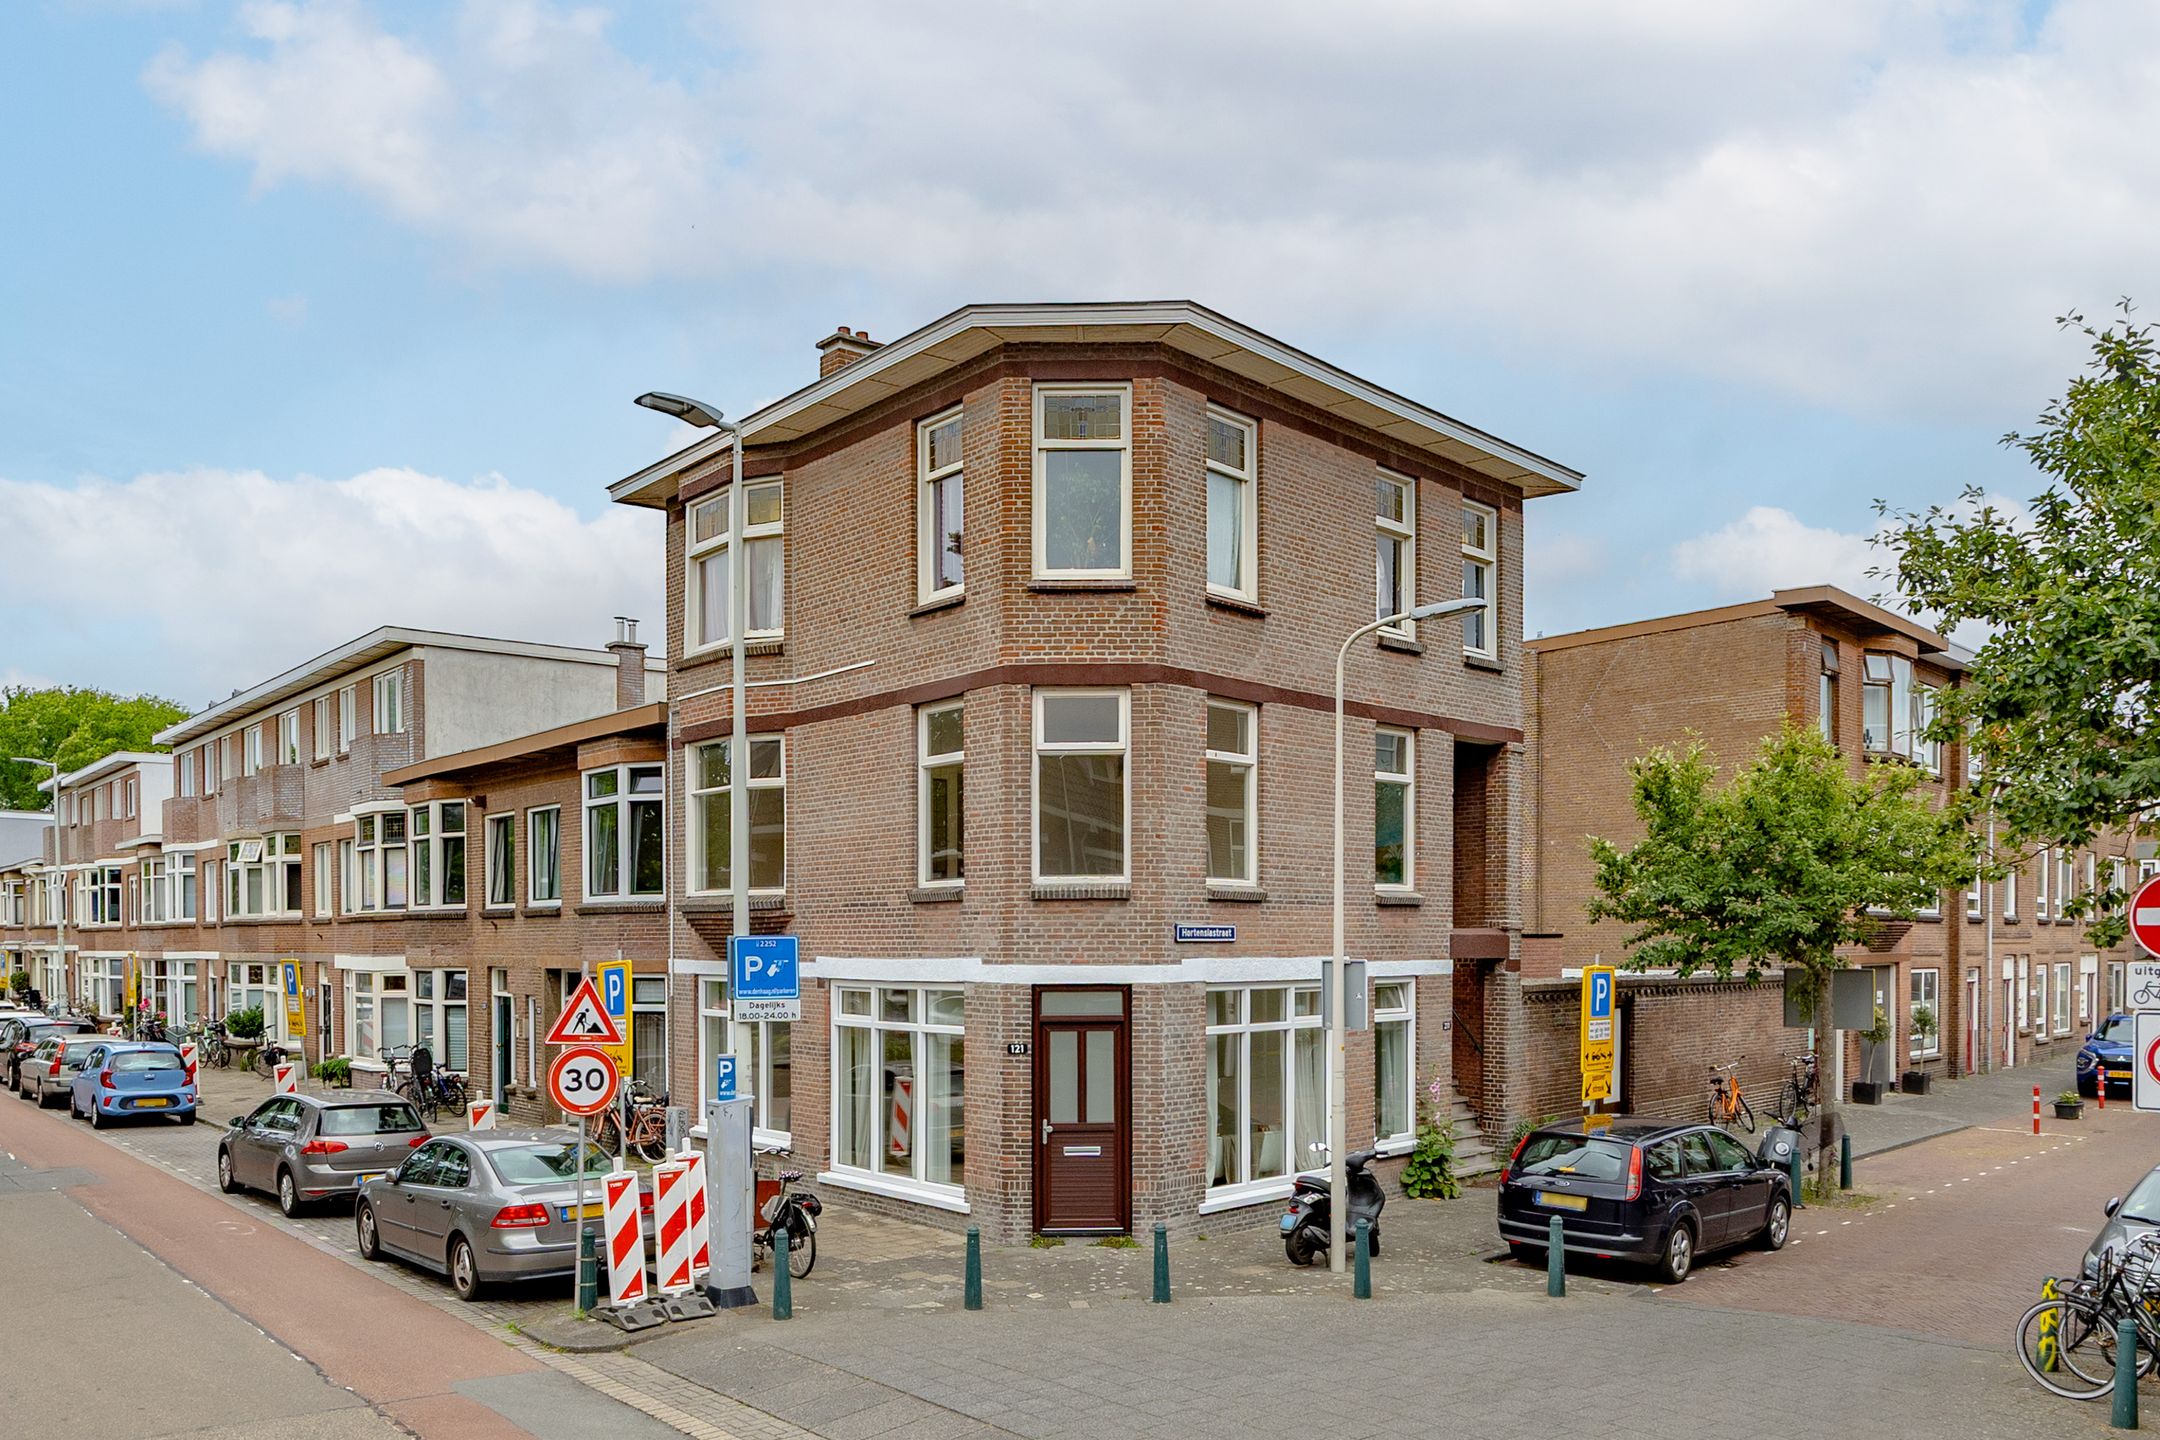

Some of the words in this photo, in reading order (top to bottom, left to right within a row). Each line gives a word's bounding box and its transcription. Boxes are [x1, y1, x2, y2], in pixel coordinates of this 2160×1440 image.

[1181, 928, 1232, 937] Hortensiastraat
[745, 955, 763, 981] P
[609, 974, 621, 1010] P
[1595, 978, 1607, 1012] P
[749, 1002, 785, 1010] Dagelijks
[739, 1012, 788, 1020] 18.00-24.00
[1011, 1045, 1024, 1053] 121
[719, 1060, 733, 1078] P
[564, 1068, 605, 1092] 30
